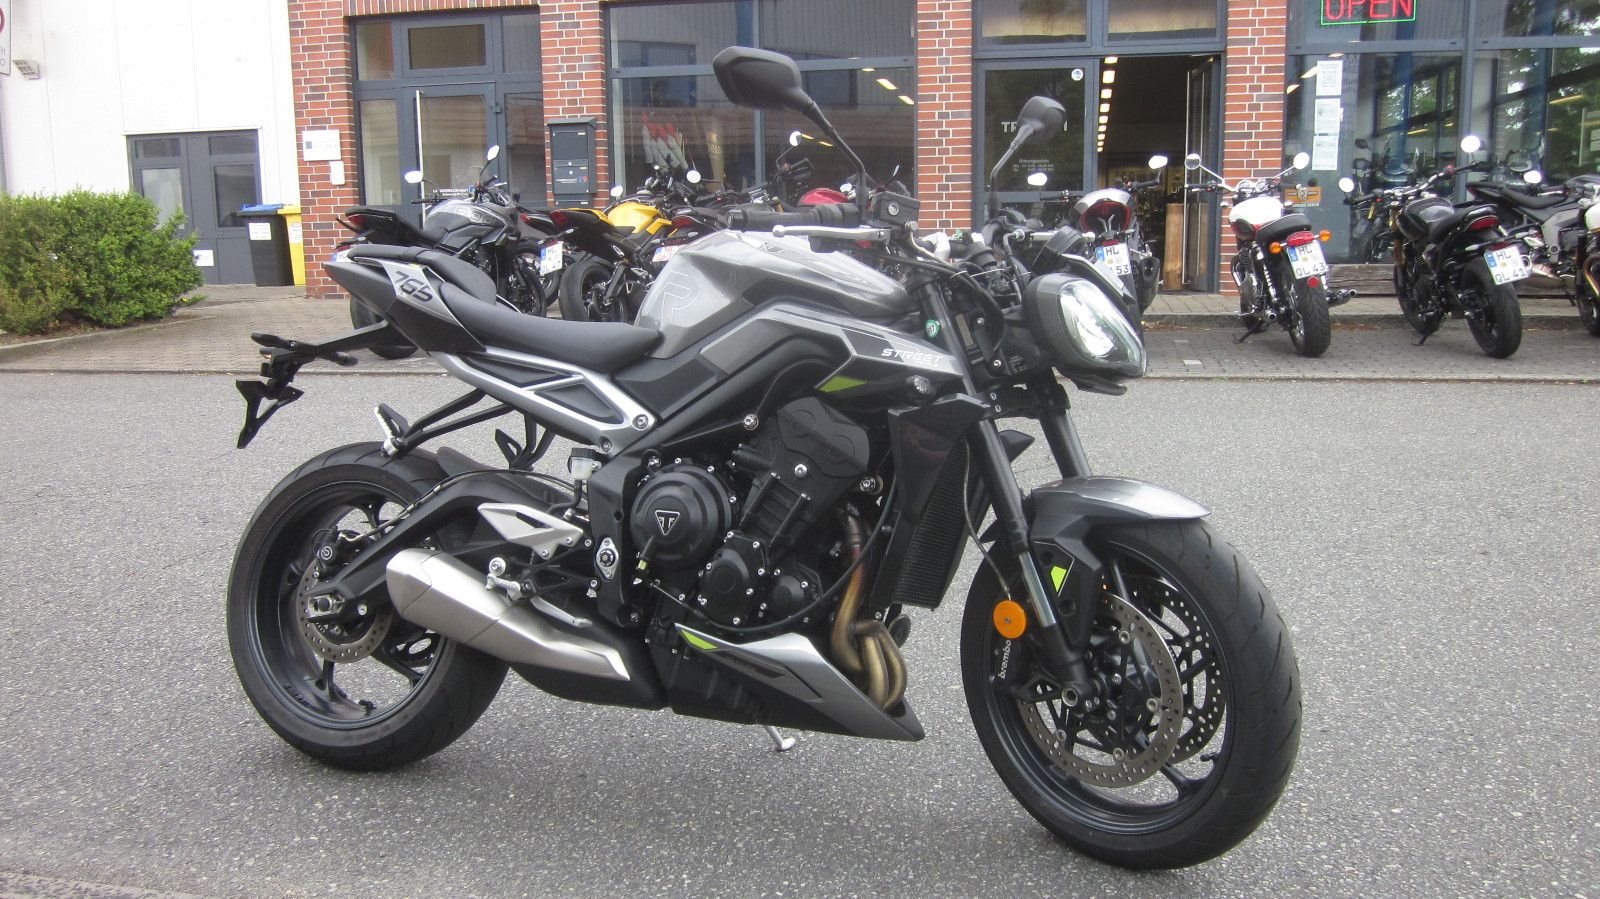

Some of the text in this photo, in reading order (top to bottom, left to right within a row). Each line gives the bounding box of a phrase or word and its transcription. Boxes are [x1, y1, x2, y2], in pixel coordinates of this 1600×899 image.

[1325, 0, 1413, 20] OPEN
[1106, 246, 1120, 256] HL
[1116, 265, 1129, 275] 53
[394, 270, 433, 302] 765
[881, 348, 944, 363] STREET
[997, 639, 1012, 680] brembo
